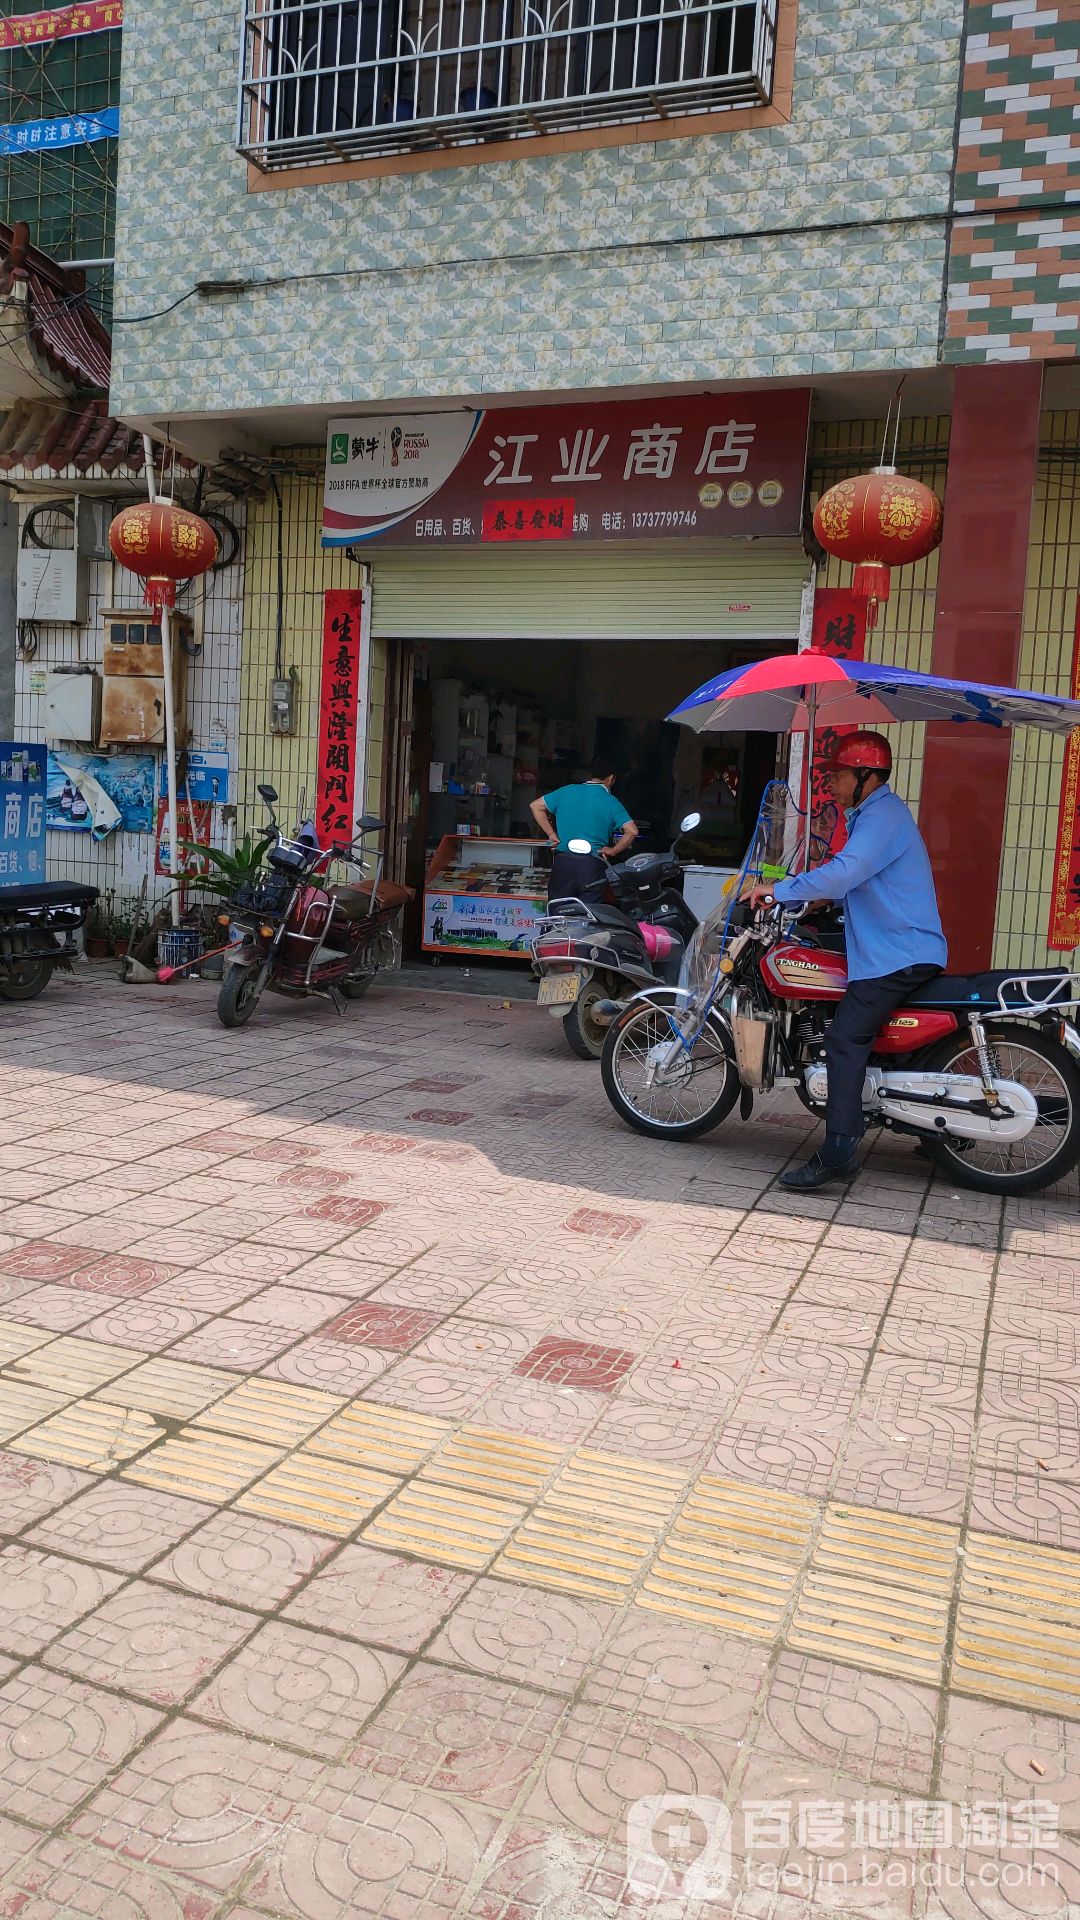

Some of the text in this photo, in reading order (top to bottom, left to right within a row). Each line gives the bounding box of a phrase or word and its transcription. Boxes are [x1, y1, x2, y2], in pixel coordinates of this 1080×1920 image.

[17, 118, 102, 145] 时时注意安全
[351, 437, 379, 460] 蒙牛
[403, 438, 430, 449] RUSSIA
[483, 419, 757, 487] 江业商店
[403, 450, 420, 459] 2018
[329, 476, 429, 491] 2018 FIFA 世界杯全球官方赞助商
[415, 518, 484, 537] 日用品、百货、
[4, 792, 44, 839] 商店
